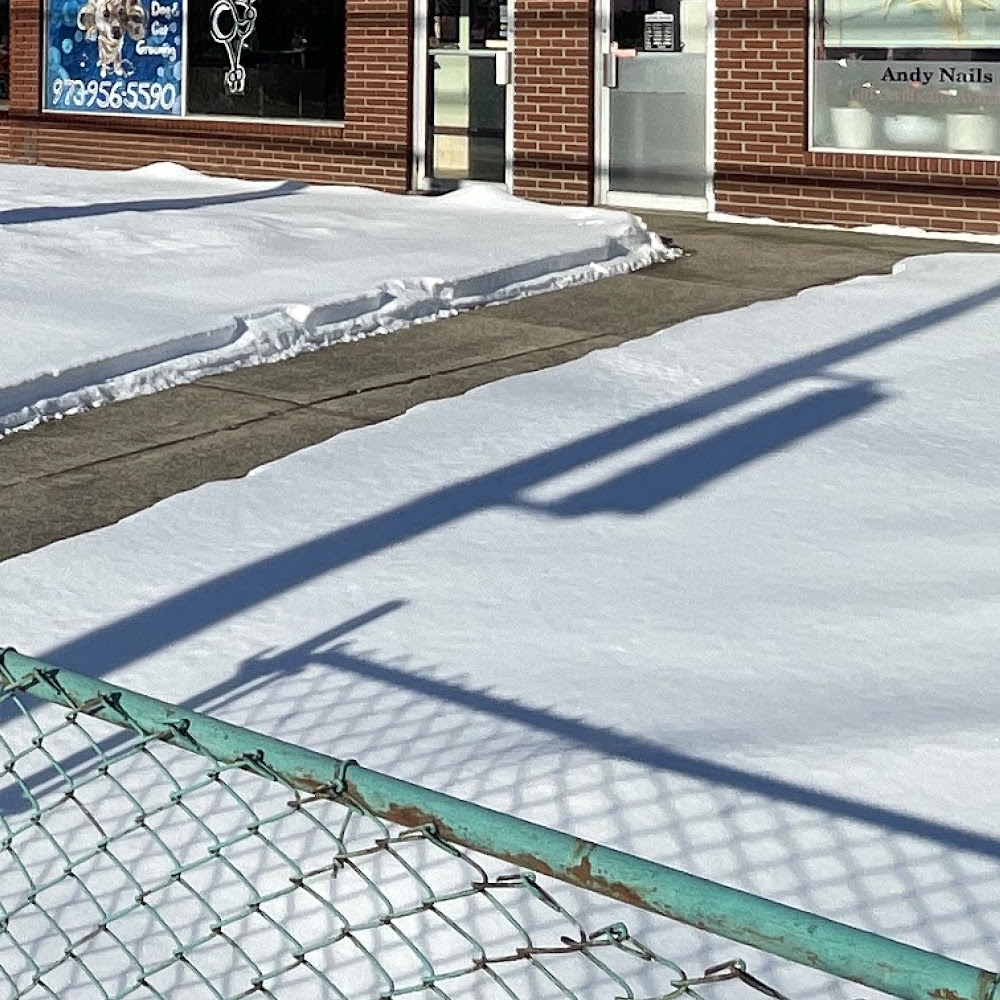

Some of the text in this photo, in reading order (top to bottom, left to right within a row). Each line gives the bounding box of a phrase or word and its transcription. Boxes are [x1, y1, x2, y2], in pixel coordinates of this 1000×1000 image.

[881, 66, 994, 85] Andy Nails
[52, 78, 176, 110] 973-956-5590
